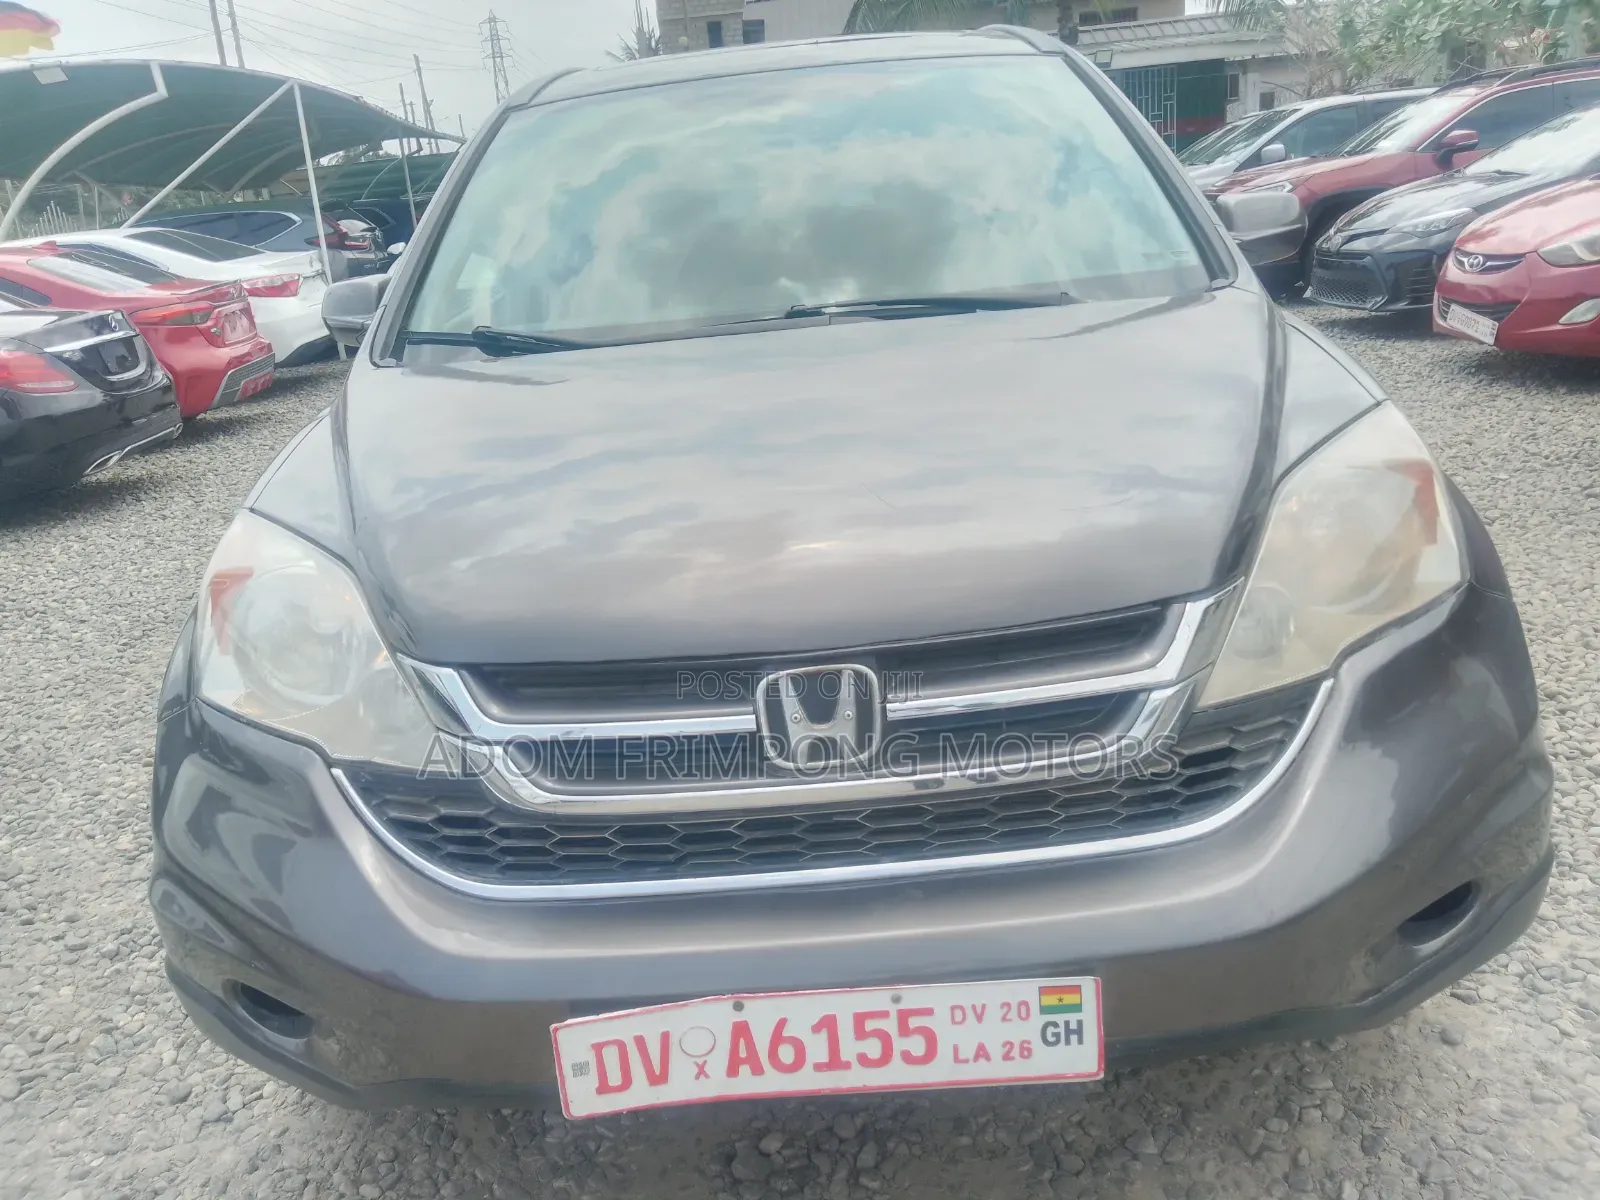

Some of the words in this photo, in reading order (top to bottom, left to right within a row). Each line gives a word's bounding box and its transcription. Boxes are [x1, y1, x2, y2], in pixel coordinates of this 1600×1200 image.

[950, 1002, 987, 1025] DV
[1000, 999, 1031, 1022] 20
[1040, 1019, 1084, 1048] GH
[590, 1030, 670, 1095] DV
[726, 1007, 939, 1078] A6155
[953, 1041, 992, 1064] LA
[1001, 1039, 1033, 1062] 26
